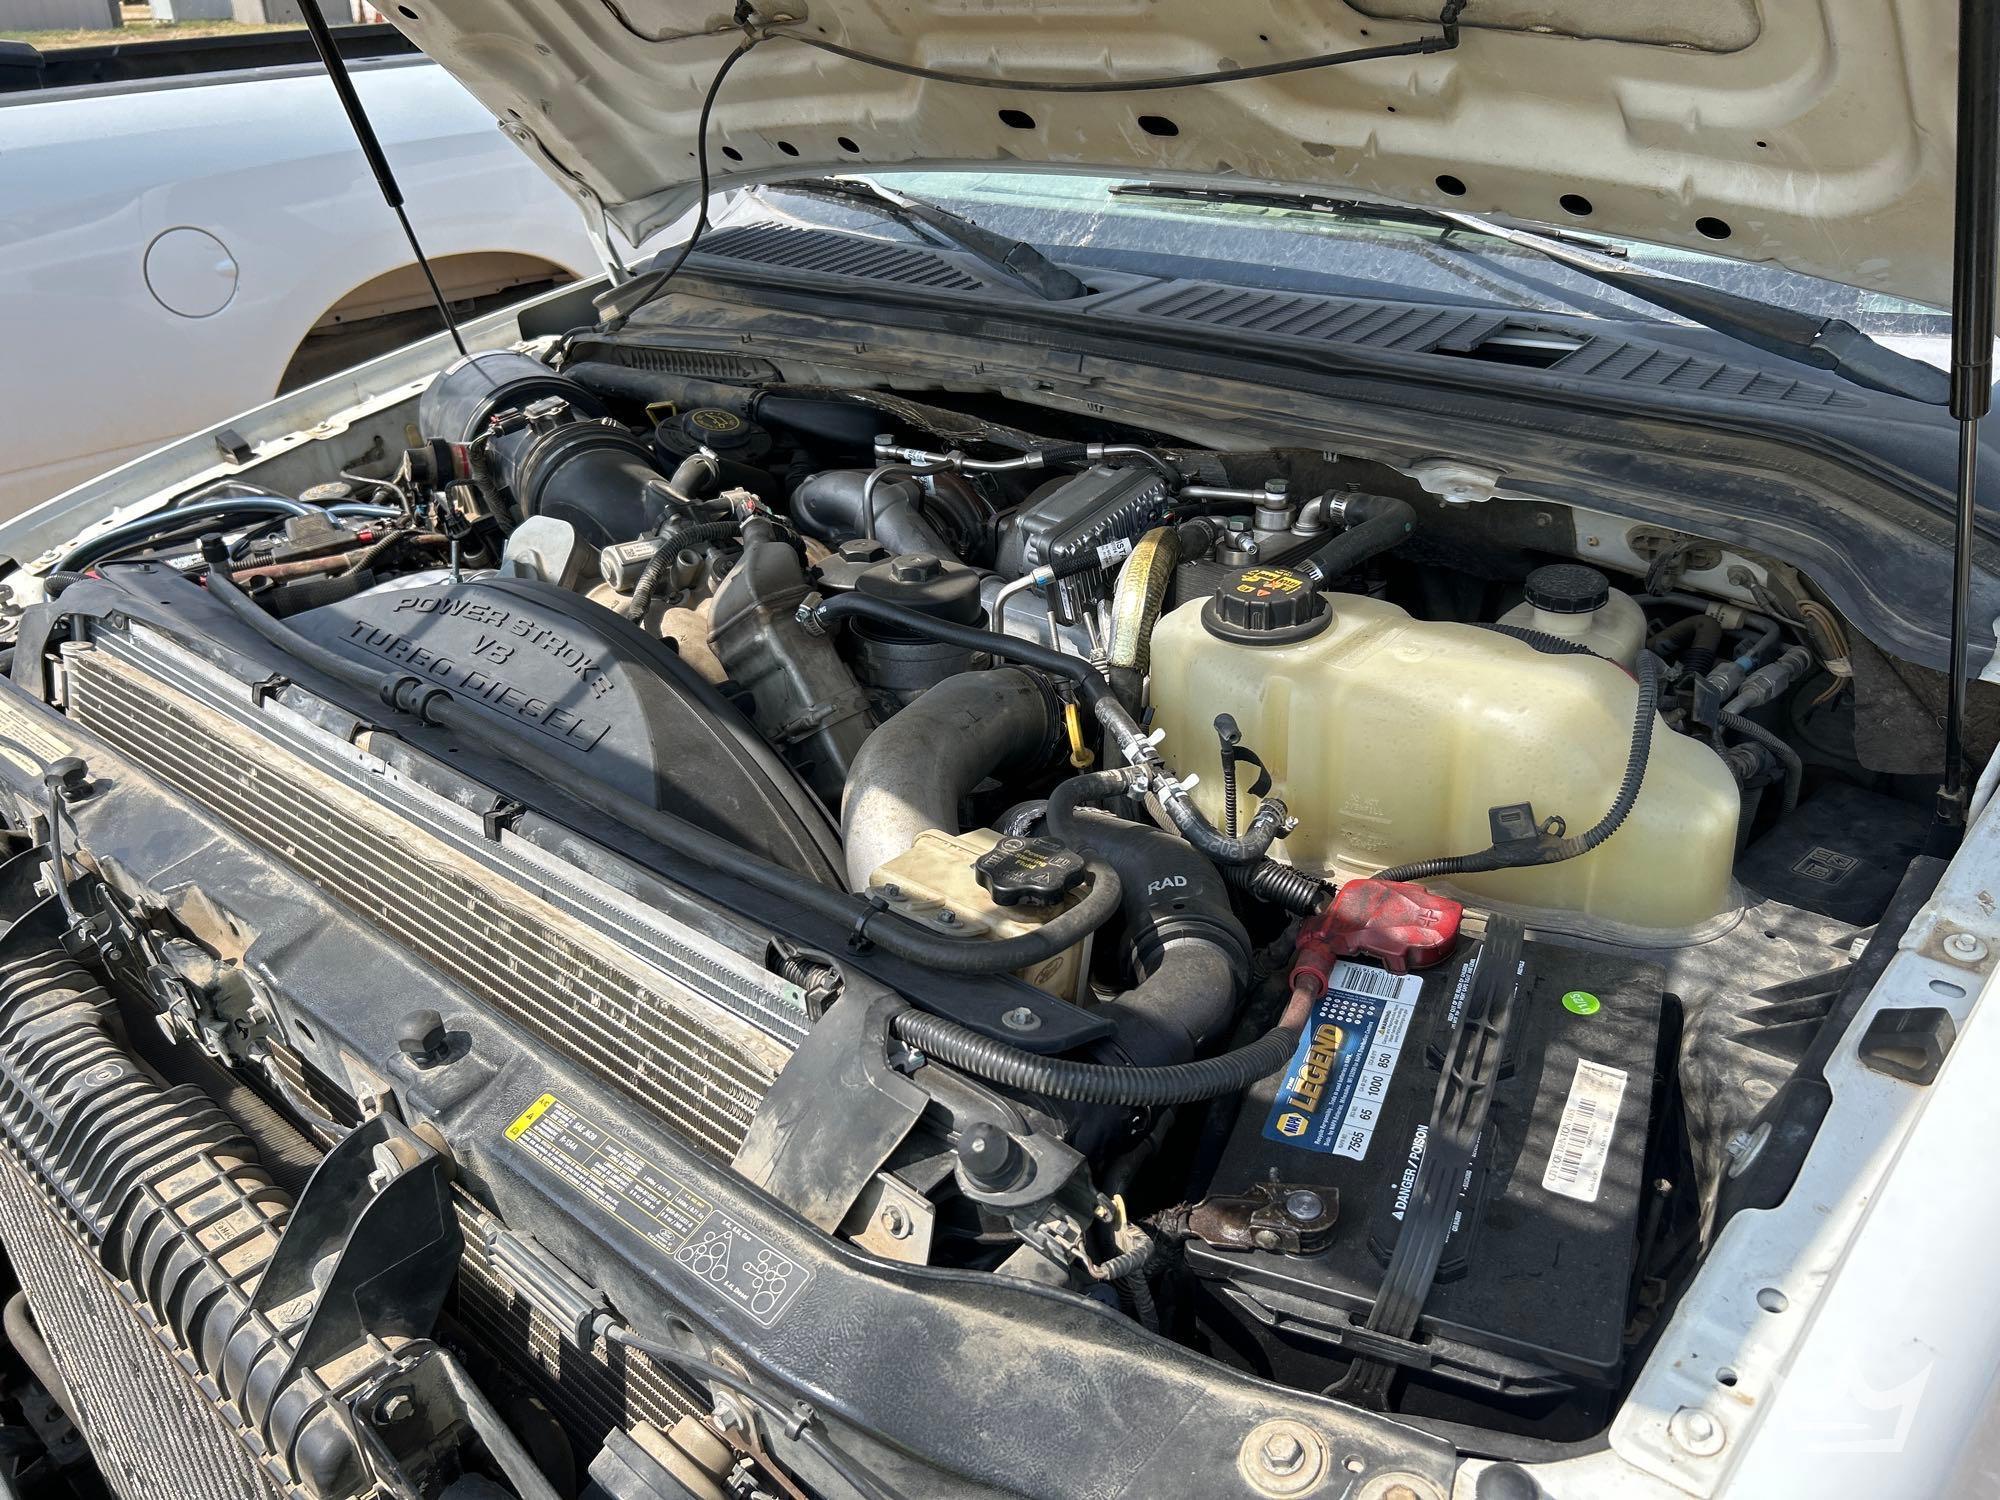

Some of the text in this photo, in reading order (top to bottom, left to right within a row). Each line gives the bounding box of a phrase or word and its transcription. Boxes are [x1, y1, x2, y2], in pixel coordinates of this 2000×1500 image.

[393, 597, 614, 699] POWER STROKE
[351, 620, 588, 742] TURBO DIESEL
[1024, 849, 1048, 860] Power
[1015, 860, 1037, 869] Fluid
[1148, 876, 1187, 896] RAD
[1376, 1052, 1392, 1069] 850
[1282, 1021, 1346, 1134] NAPA LEGEND
[1367, 1074, 1384, 1097] 1000
[1358, 1108, 1373, 1120] 65
[572, 1121, 586, 1133] SAE
[581, 1127, 598, 1141] J639
[1555, 1121, 1572, 1153] DENTON
[558, 1134, 579, 1151] R-134A
[1347, 1130, 1365, 1152] 7565
[1394, 1123, 1429, 1210] DANGER / POISON
[1551, 1153, 1562, 1163] OF
[1546, 1163, 1559, 1181] CITY
[740, 1232, 752, 1242] Gas
[732, 1286, 749, 1301] Diesel
